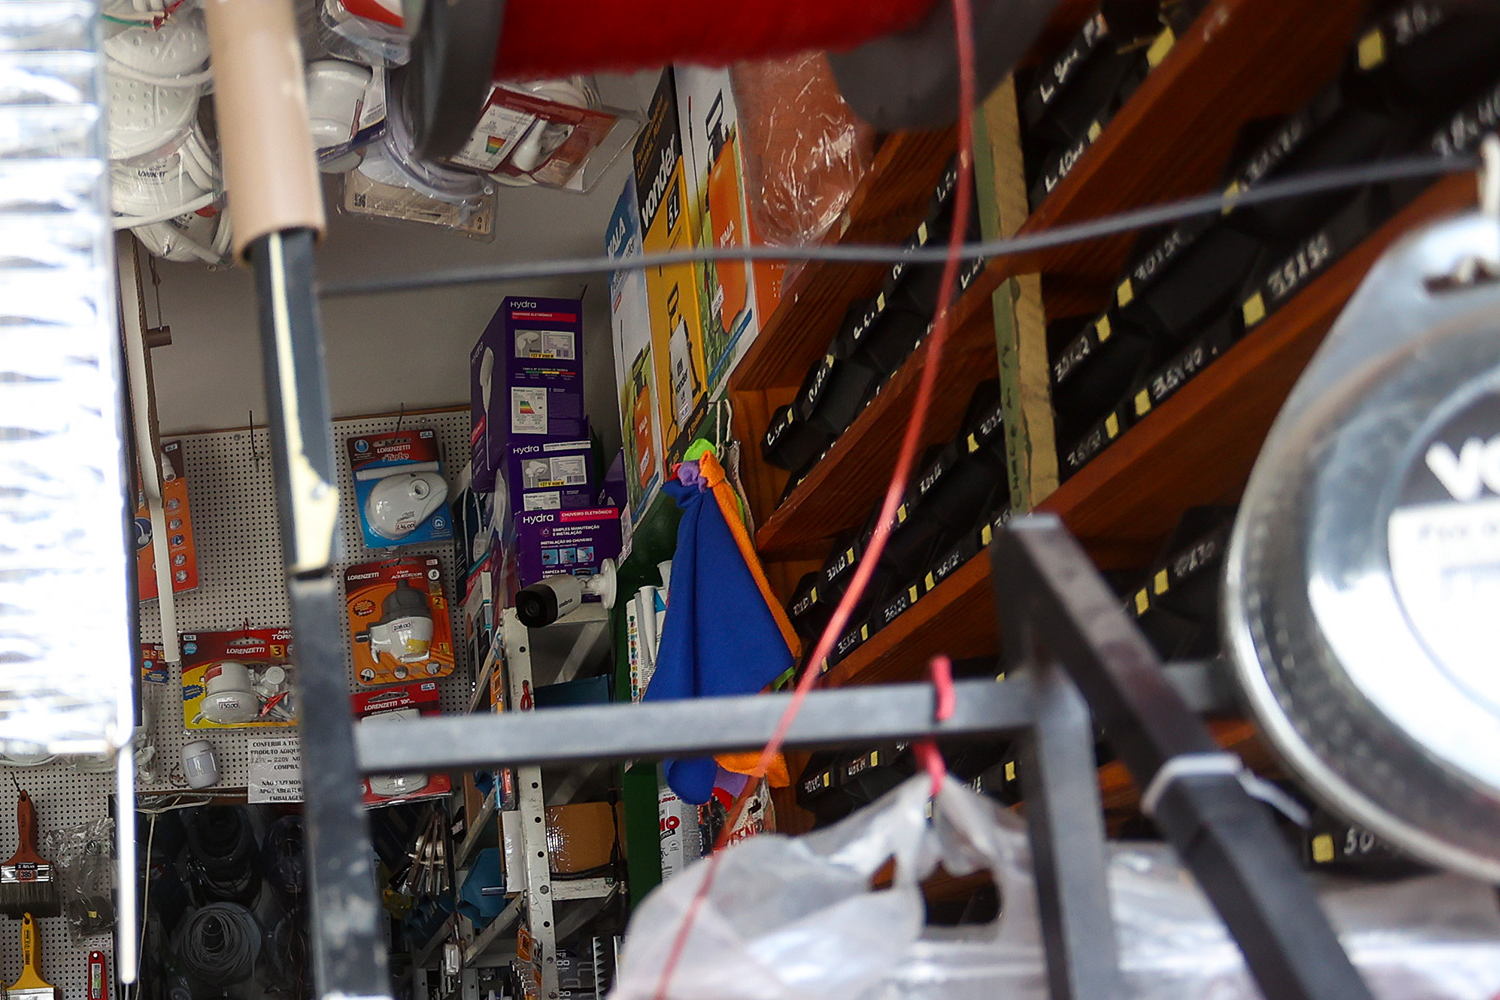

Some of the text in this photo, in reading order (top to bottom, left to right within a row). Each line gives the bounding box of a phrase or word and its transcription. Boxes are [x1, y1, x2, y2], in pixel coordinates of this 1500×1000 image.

[641, 133, 677, 229] vonder
[510, 301, 537, 309] Hydra
[377, 444, 411, 453] LORENZETTI
[513, 445, 540, 455] Hydra
[523, 514, 554, 525] Hydra
[348, 572, 380, 581] LORENZETTI
[364, 701, 398, 711] LORENZETTI
